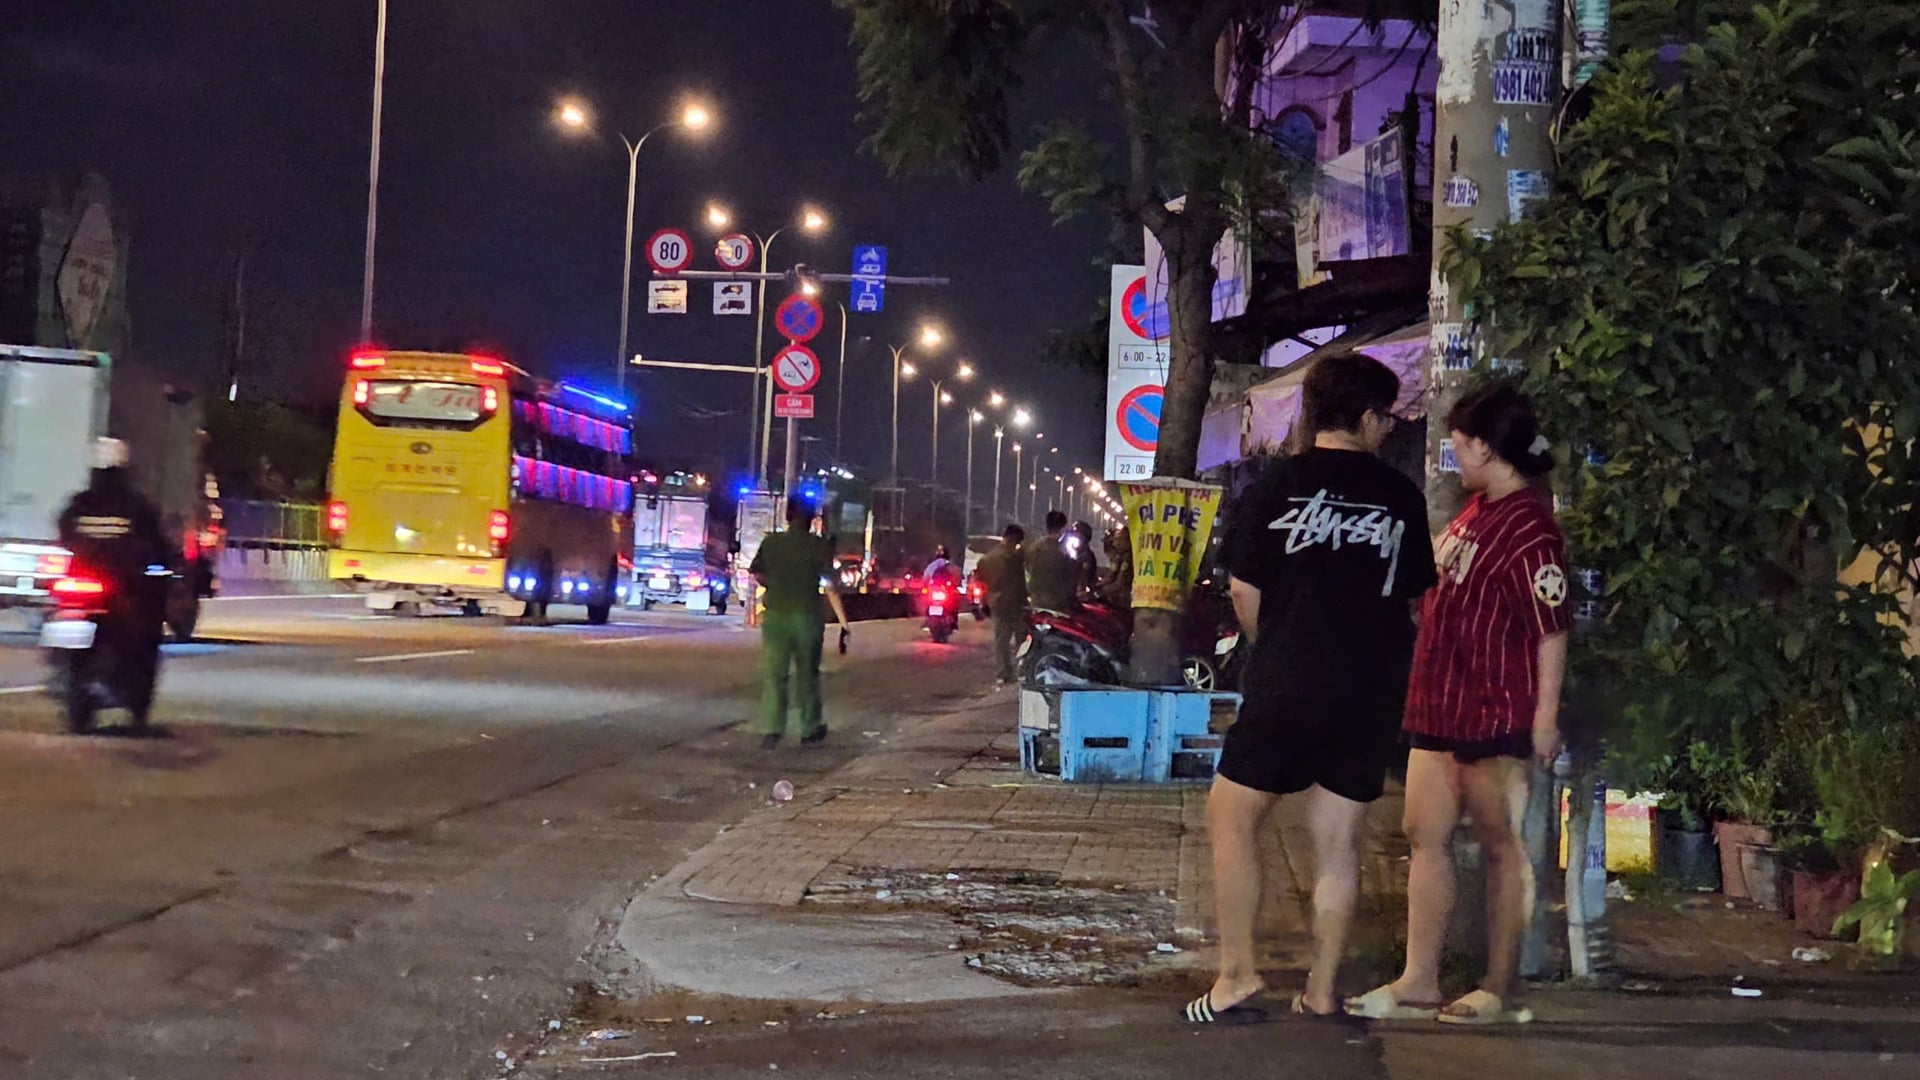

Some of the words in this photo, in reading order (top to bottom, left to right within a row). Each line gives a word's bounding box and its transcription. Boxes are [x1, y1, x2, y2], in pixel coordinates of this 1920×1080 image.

[660, 242, 680, 260] 80
[1123, 352, 1144, 362] 6:00
[1120, 464, 1146, 475] 22:00
